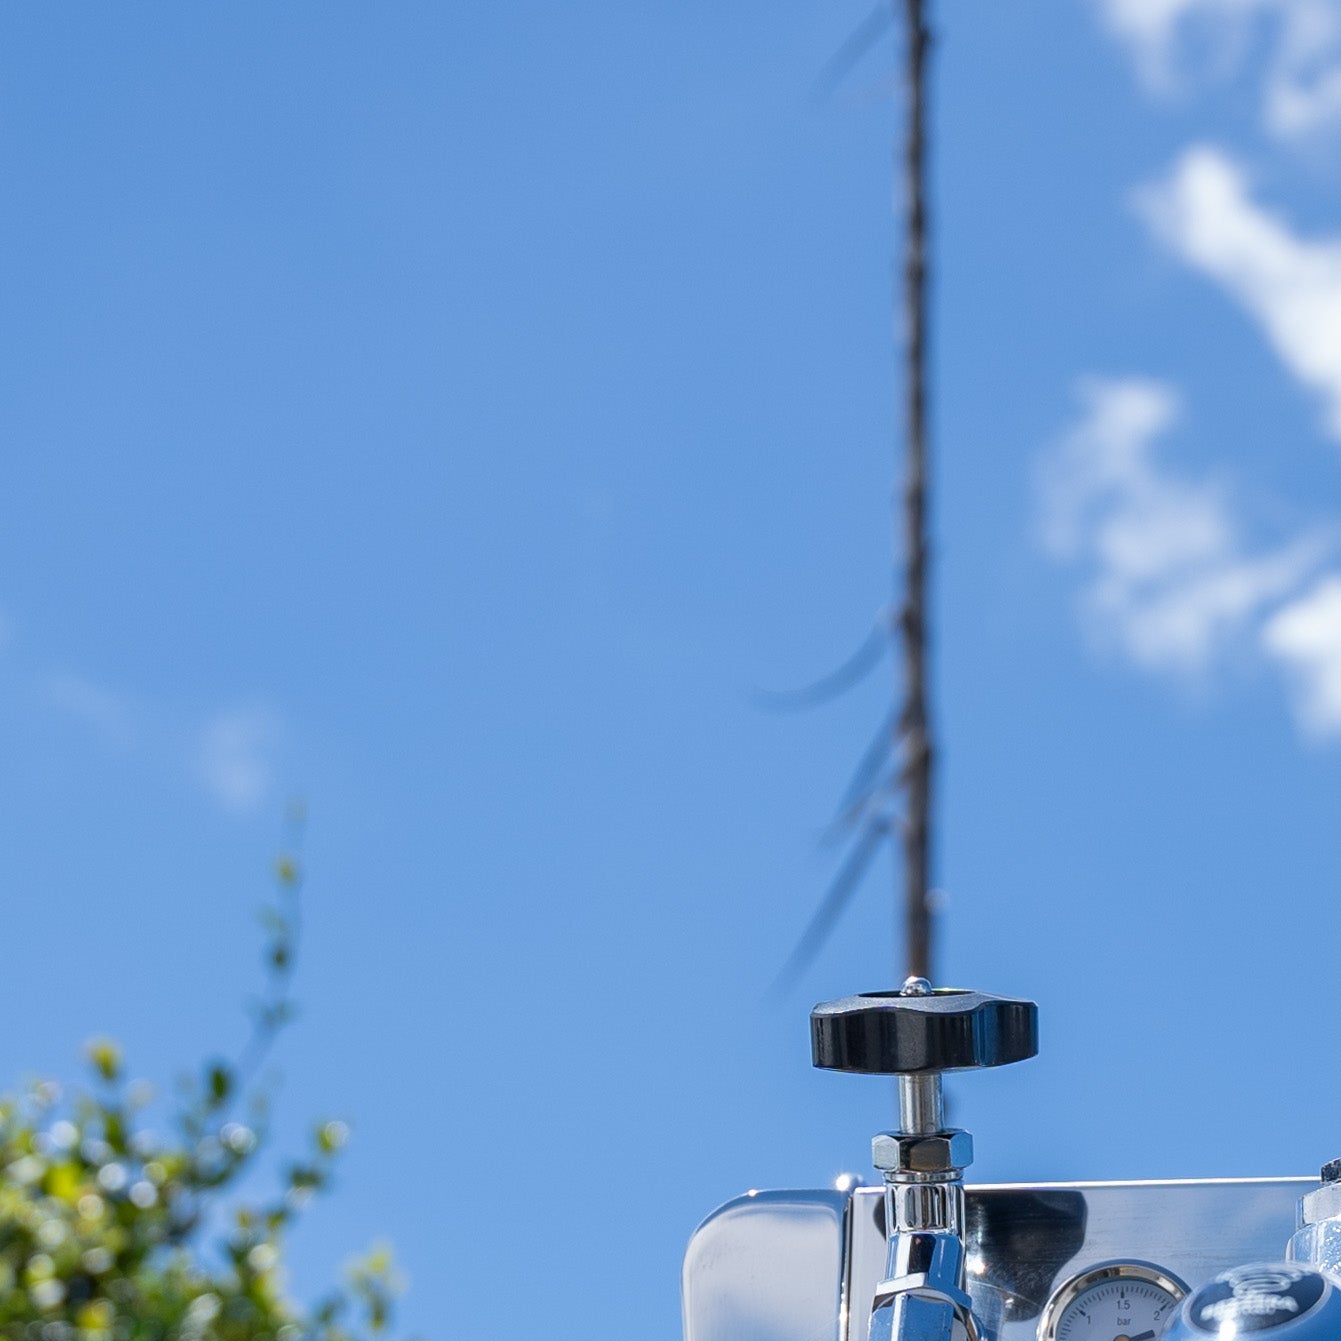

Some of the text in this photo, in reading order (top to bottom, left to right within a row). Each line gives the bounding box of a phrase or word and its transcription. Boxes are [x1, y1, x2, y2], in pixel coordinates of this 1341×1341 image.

[1116, 1300, 1131, 1310] 1.5
[1086, 1315, 1092, 1325] 1
[1153, 1310, 1161, 1321] 2
[1116, 1317, 1131, 1326] bar
